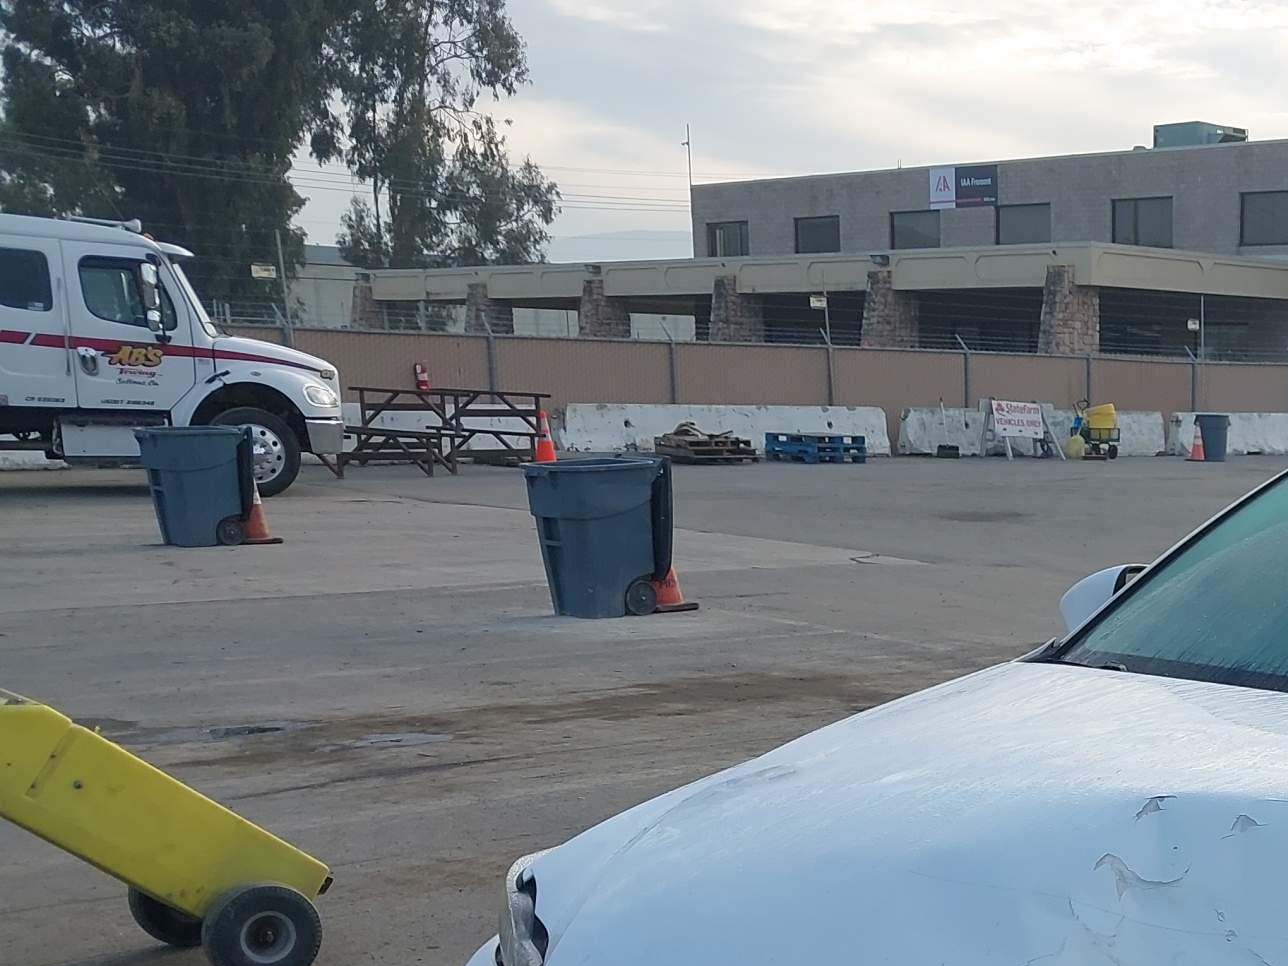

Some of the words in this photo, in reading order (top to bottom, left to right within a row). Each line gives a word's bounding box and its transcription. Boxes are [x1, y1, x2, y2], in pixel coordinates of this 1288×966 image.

[960, 177, 971, 187] IAA
[119, 368, 157, 378] Towing
[996, 418, 1025, 427] VEHICLES
